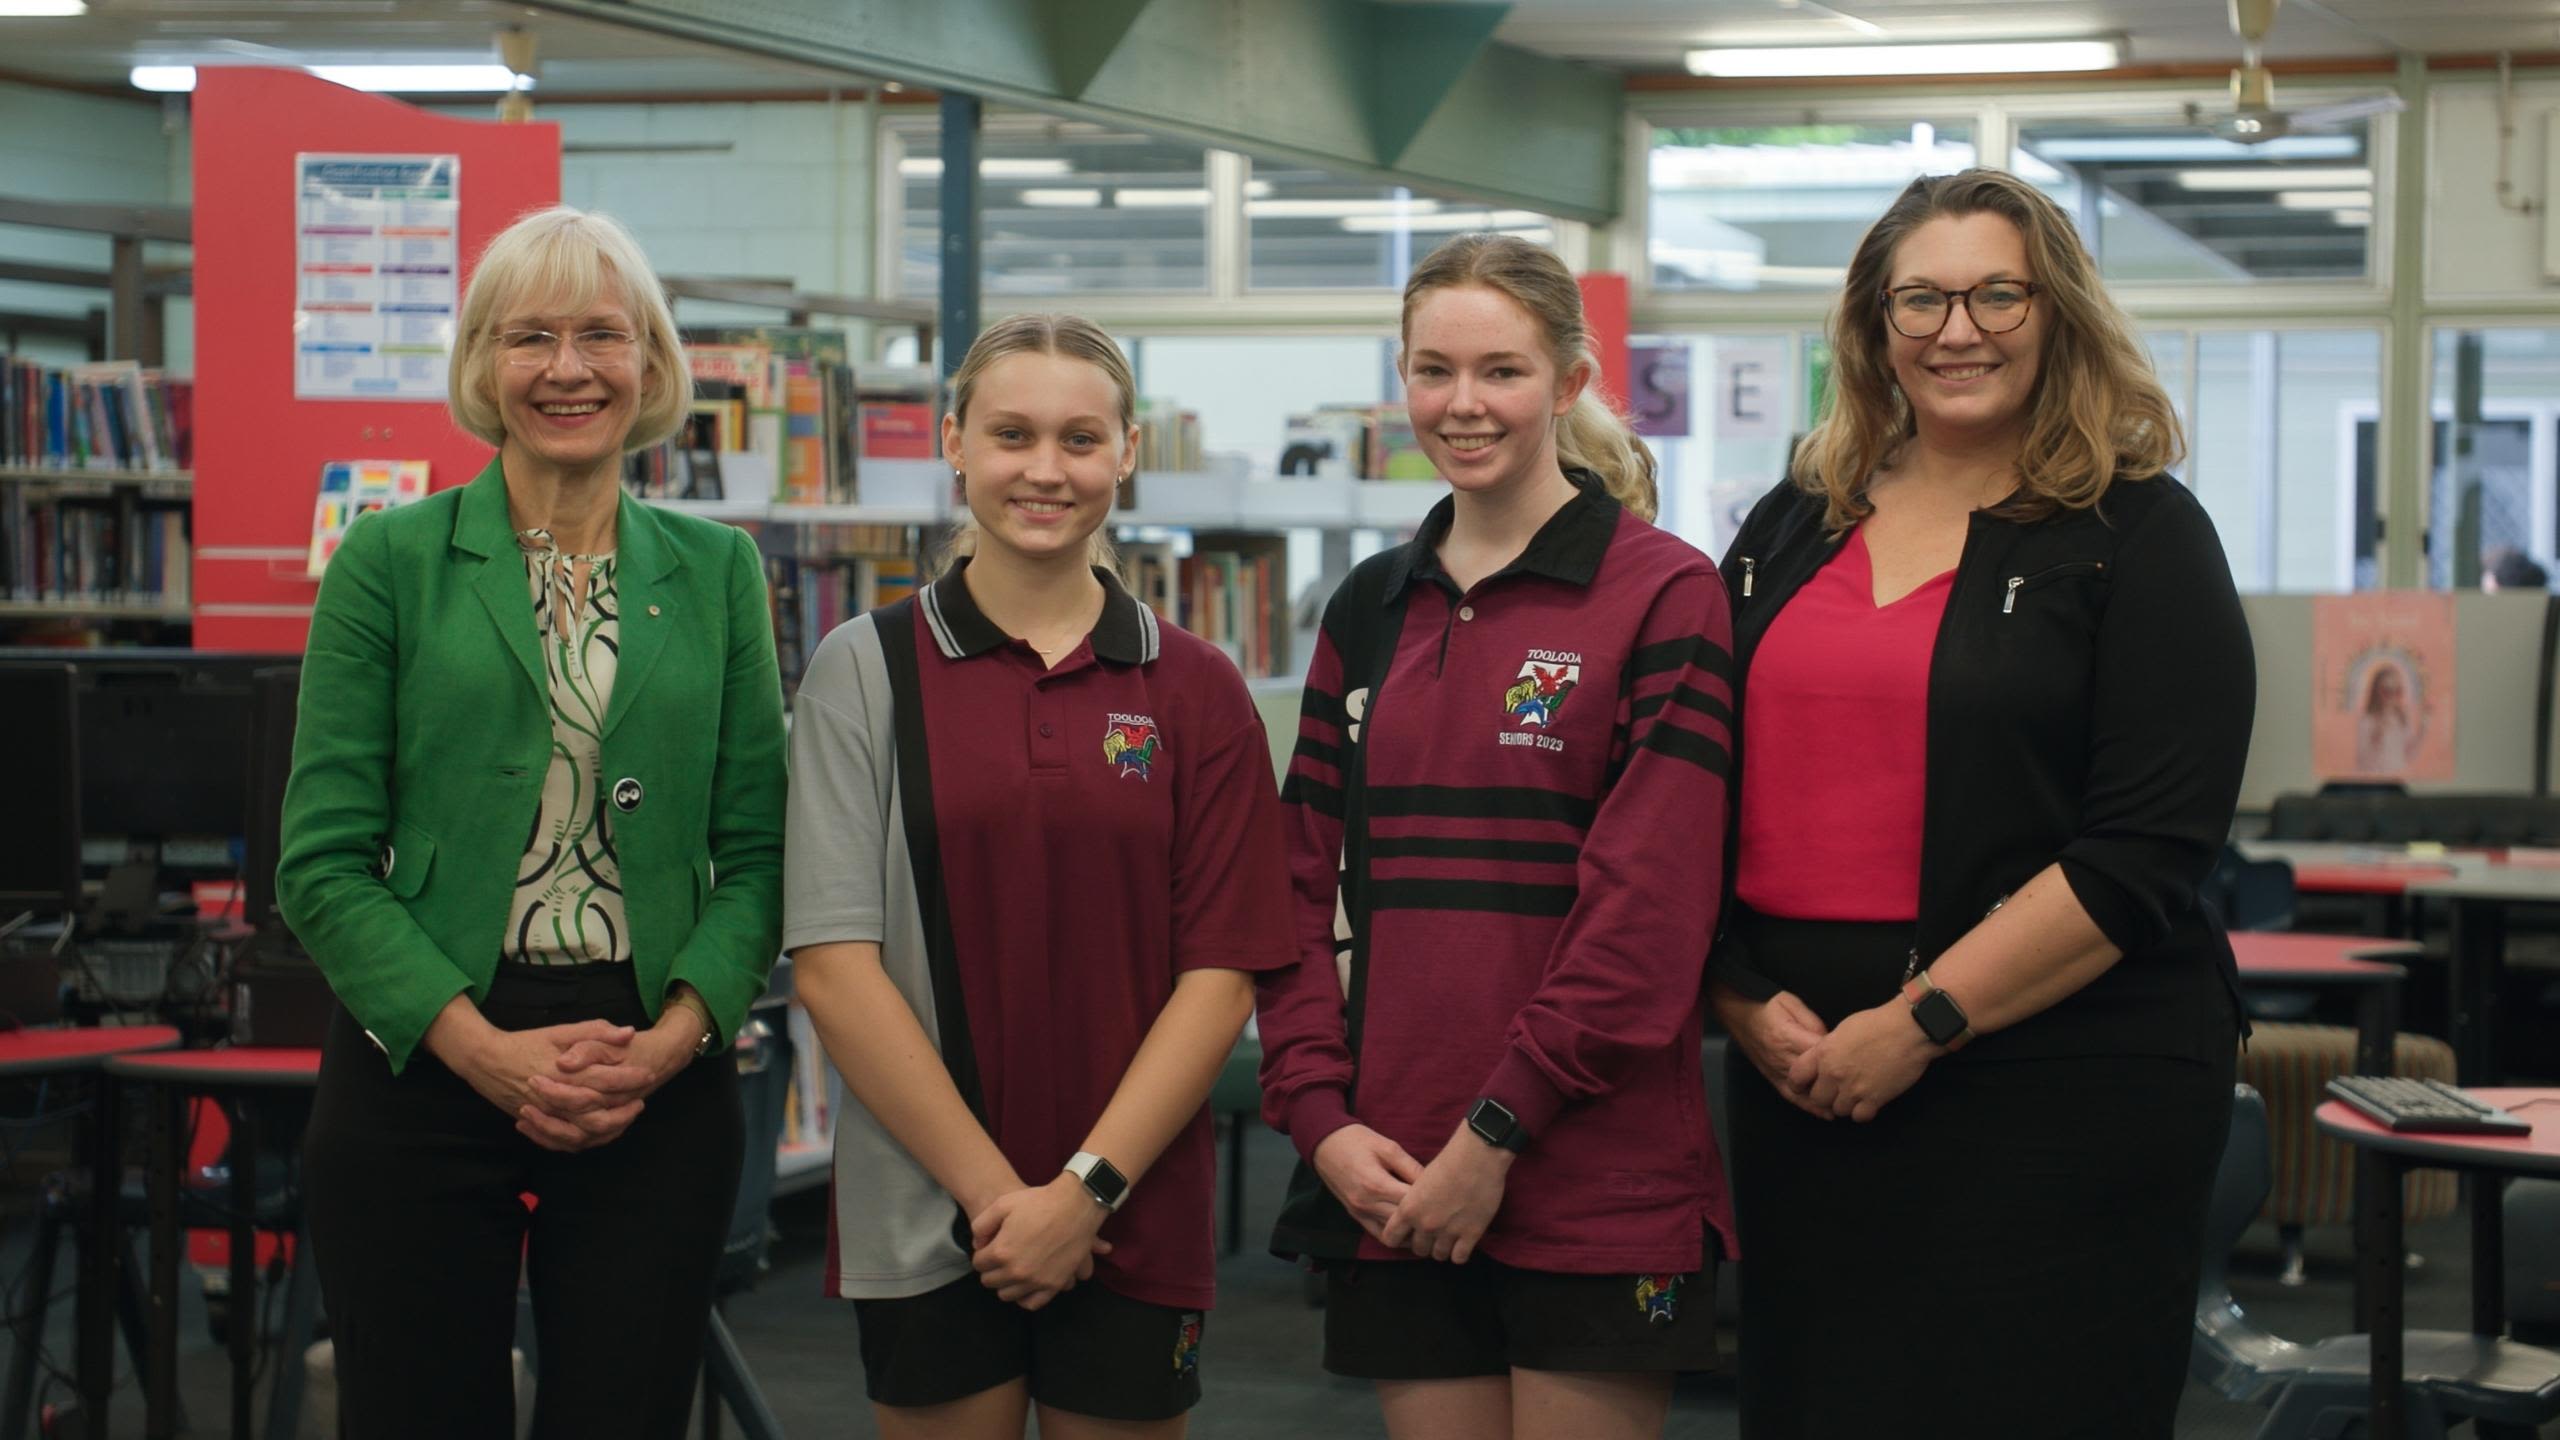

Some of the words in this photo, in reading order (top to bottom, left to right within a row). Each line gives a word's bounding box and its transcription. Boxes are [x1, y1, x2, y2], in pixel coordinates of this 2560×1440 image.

[1732, 361, 1764, 420] E
[1528, 649, 1581, 663] TOOLOOA
[1106, 713, 1155, 725] TOOLOOA
[1499, 732, 1534, 746] SENIORS
[1536, 735, 1564, 752] 2023
